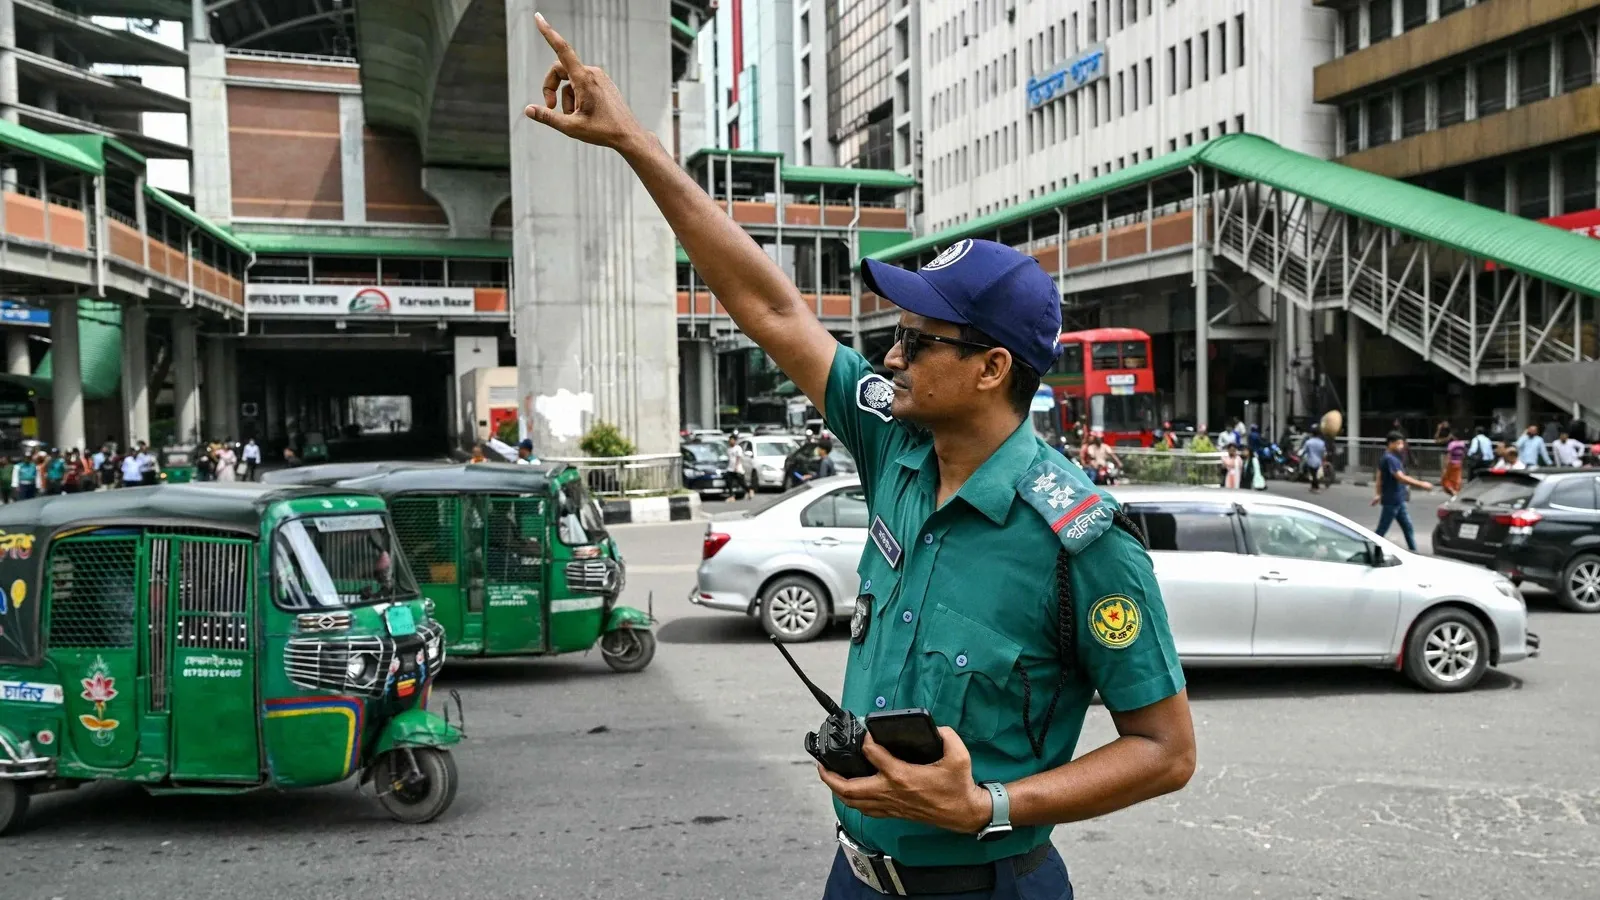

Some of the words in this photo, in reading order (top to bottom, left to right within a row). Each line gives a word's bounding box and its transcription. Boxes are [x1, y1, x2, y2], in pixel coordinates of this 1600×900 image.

[398, 296, 441, 306] Karwan
[443, 296, 472, 307] Bazar
[1066, 506, 1107, 539] পুলিশ
